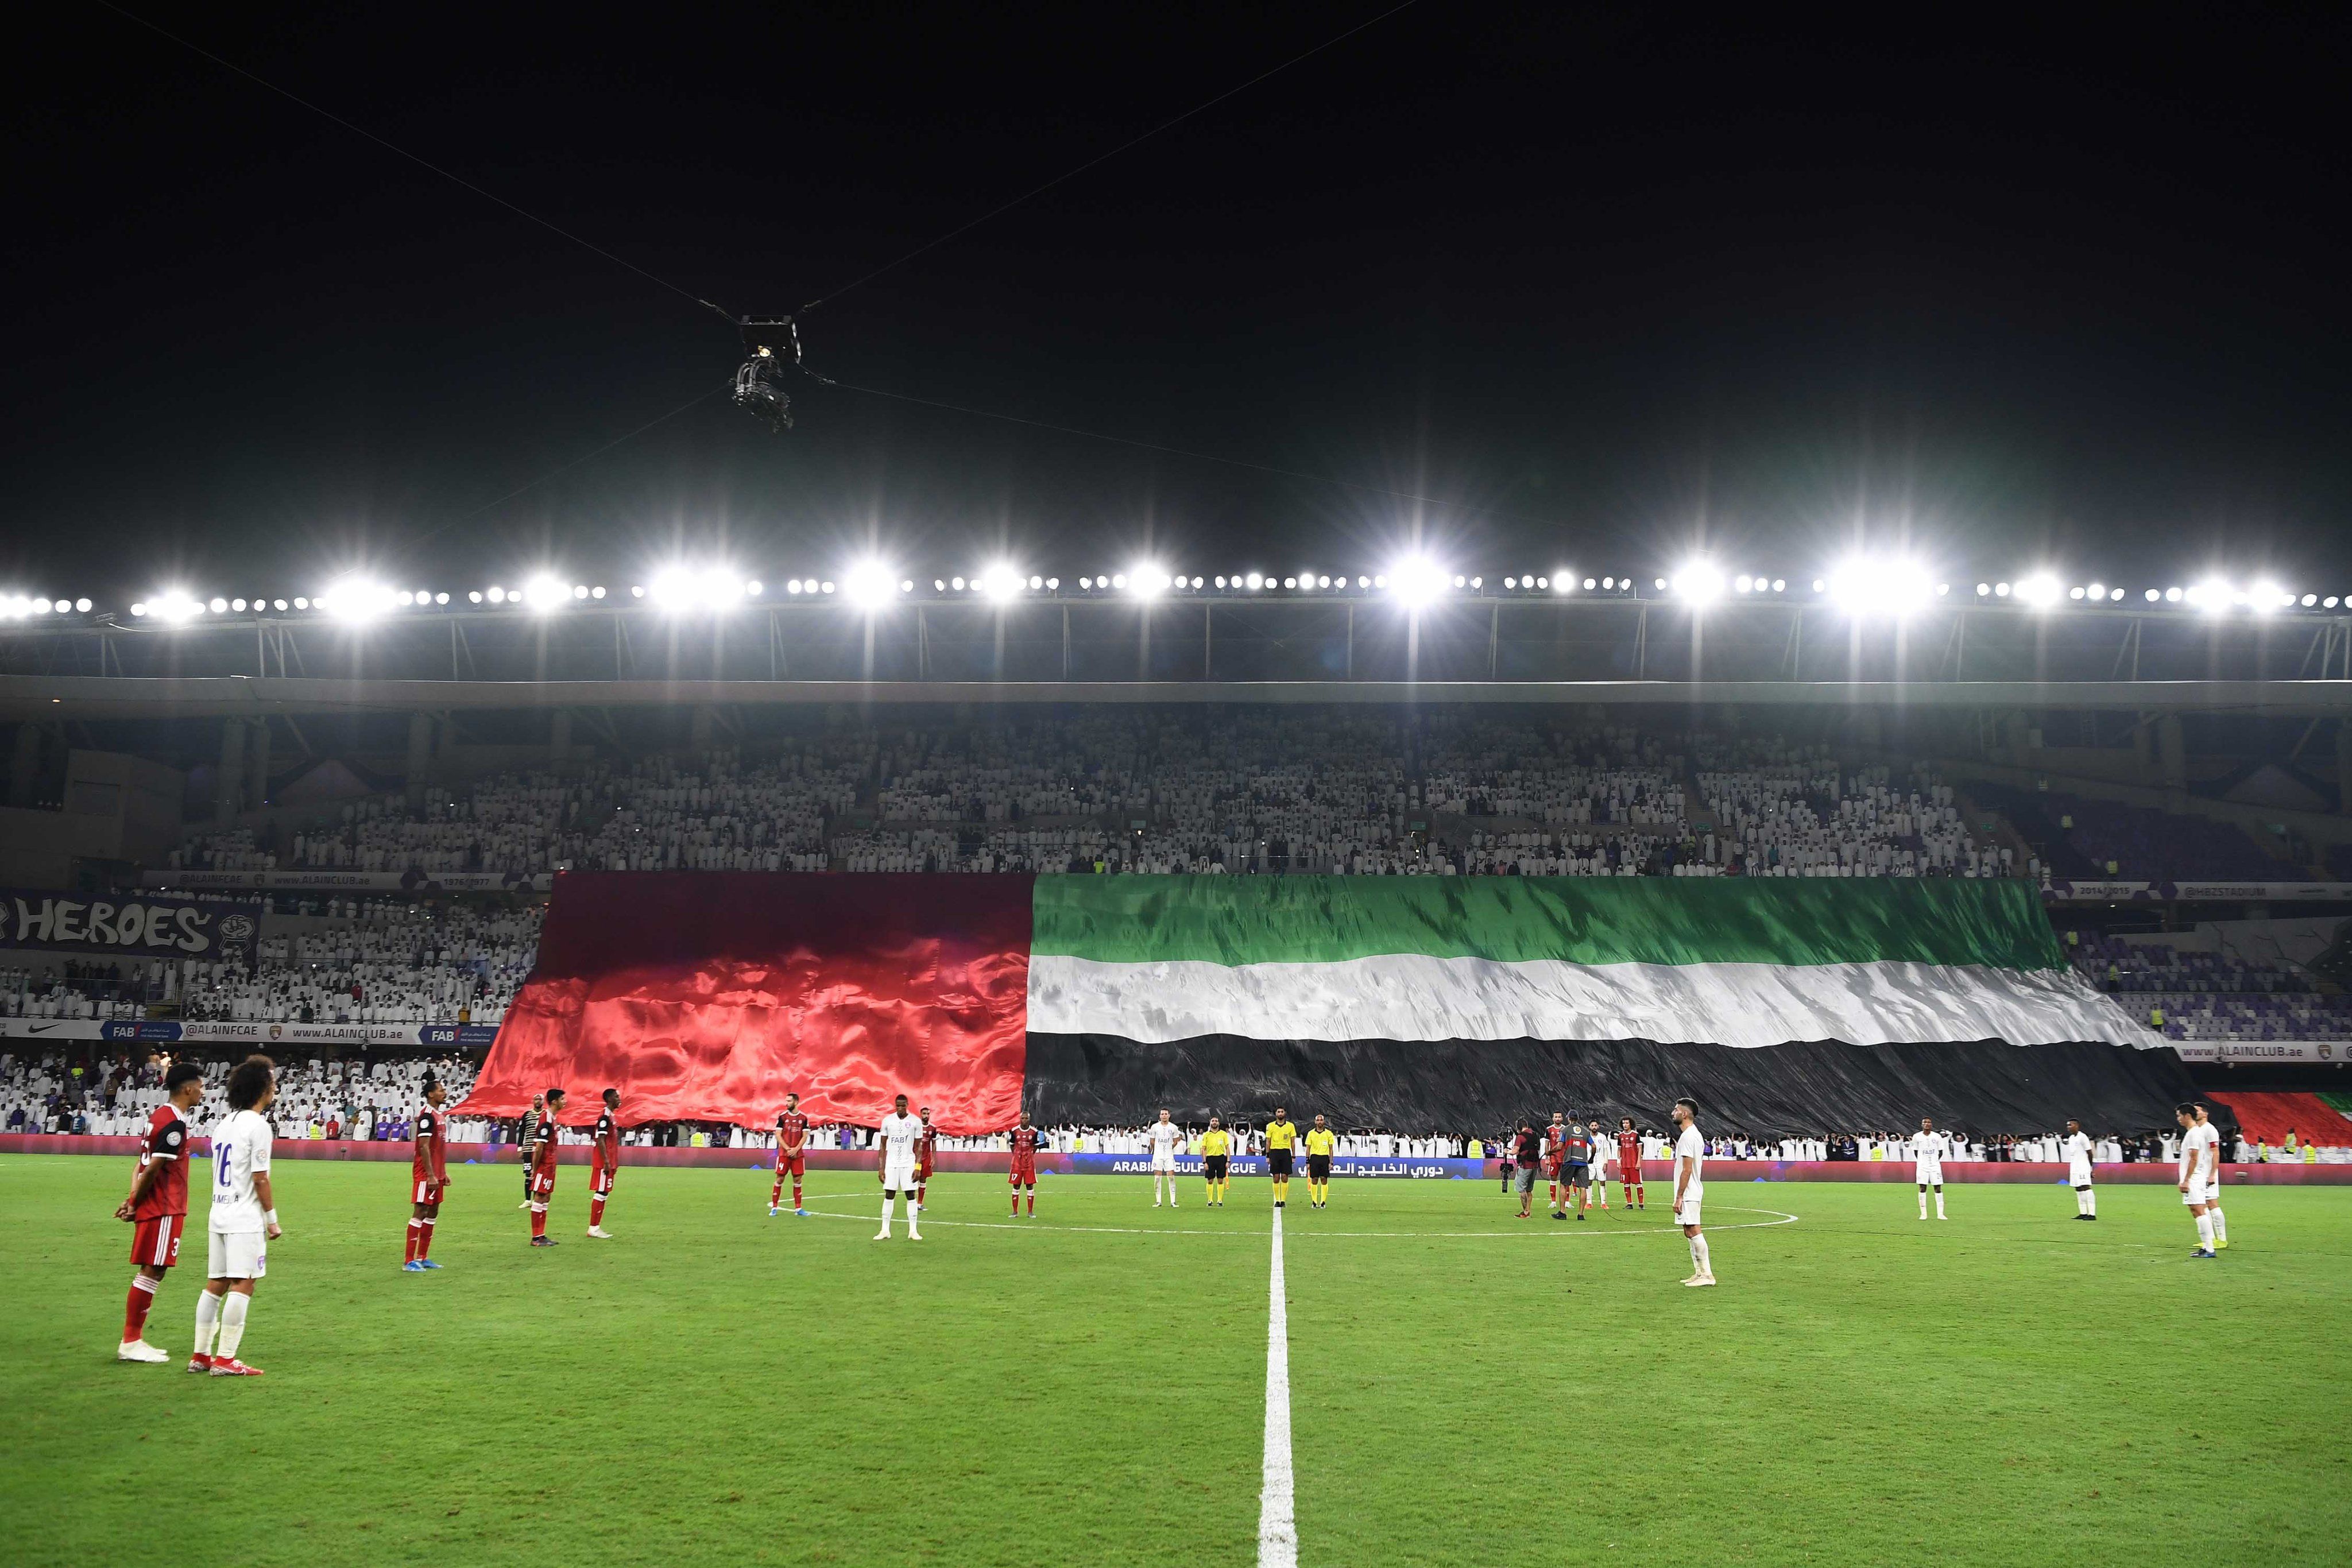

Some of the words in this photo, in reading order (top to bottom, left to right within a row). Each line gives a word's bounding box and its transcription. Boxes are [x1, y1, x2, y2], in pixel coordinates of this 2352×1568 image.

[179, 874, 242, 885] @ALAINFCAE
[274, 876, 370, 885] www.ALAINCLUB.ae
[15, 897, 211, 952] HEROES
[113, 1027, 134, 1037] FAB
[185, 1024, 258, 1037] @ALAINFCAE
[293, 1028, 403, 1039] www.ALAINCLUB.ae
[432, 1031, 454, 1042] FAB
[2183, 1047, 2303, 1056] www.ALAINCLUB.ae
[215, 1143, 232, 1187] 16
[1113, 1162, 1154, 1172] ARABI
[1174, 1162, 1204, 1172] GULF
[1357, 1163, 1407, 1177] الخليج
[1410, 1165, 1444, 1178] دوري
